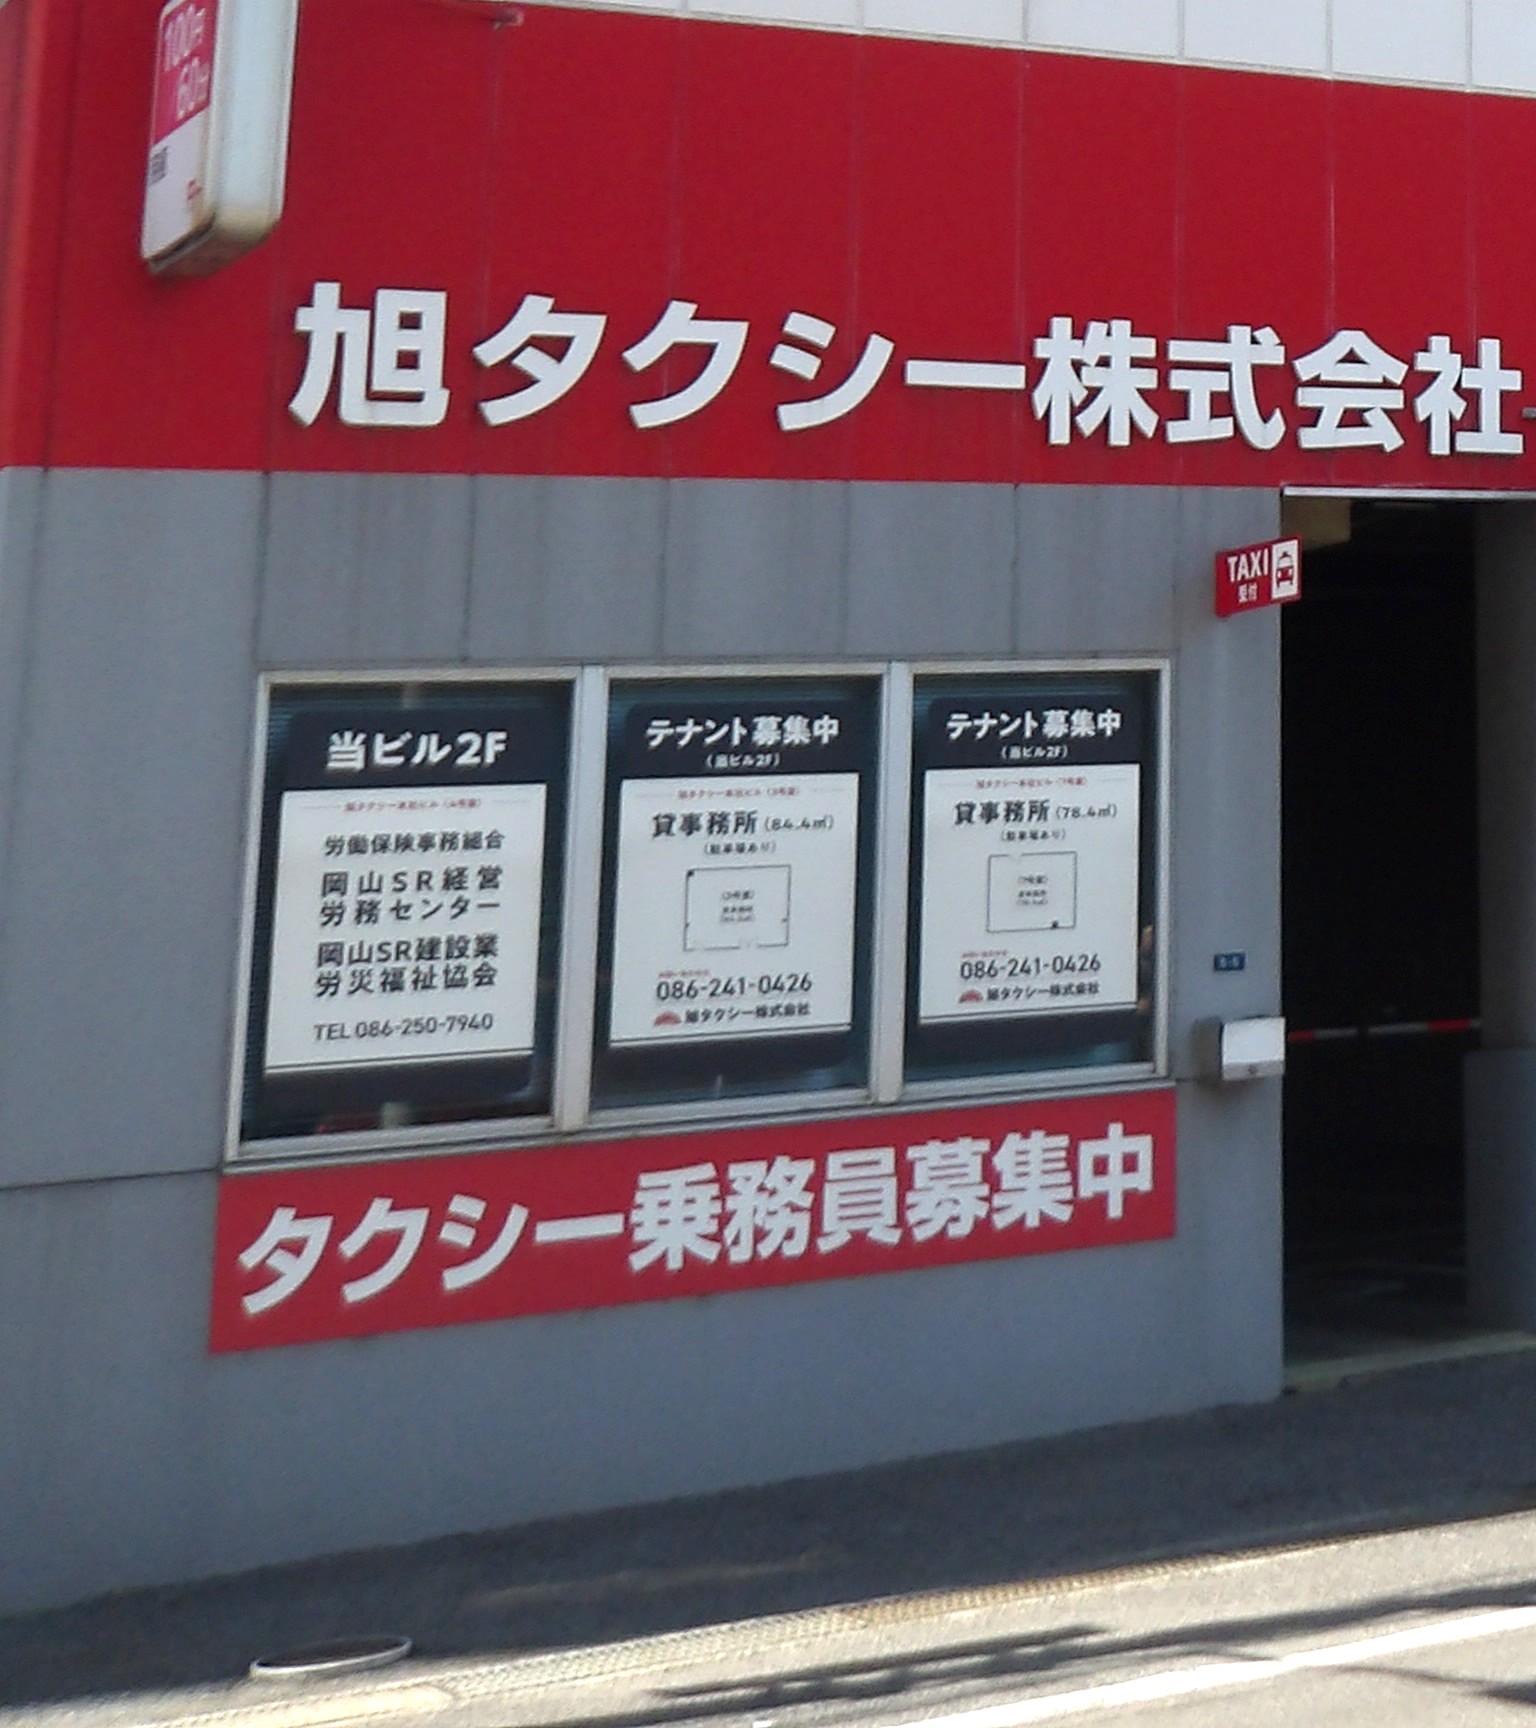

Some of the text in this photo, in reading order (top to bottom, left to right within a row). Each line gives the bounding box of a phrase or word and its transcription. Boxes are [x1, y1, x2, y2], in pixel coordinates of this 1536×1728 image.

[287, 281, 1526, 458] 旭タクシー株式会社
[1227, 548, 1269, 583] TAXI
[645, 713, 841, 750] テナント募集中
[946, 708, 1123, 740] テナント募集中
[326, 729, 509, 772] 当ビル2F
[651, 809, 760, 840] 貸事務所
[954, 798, 1052, 827] 貸事務所
[323, 828, 507, 859] 労働保険事務組合
[320, 864, 504, 900] 岡山SR経営
[319, 894, 502, 928] 労務センター
[317, 932, 501, 970] 岡山SR建設業
[959, 952, 1102, 981] 086-241-0426
[315, 962, 499, 998] 労災福祉協会
[656, 972, 813, 1001] 086-241-0426
[314, 1012, 494, 1042] TEL 086-250-7940
[237, 1121, 1156, 1317] タクシー乗務員募集中
